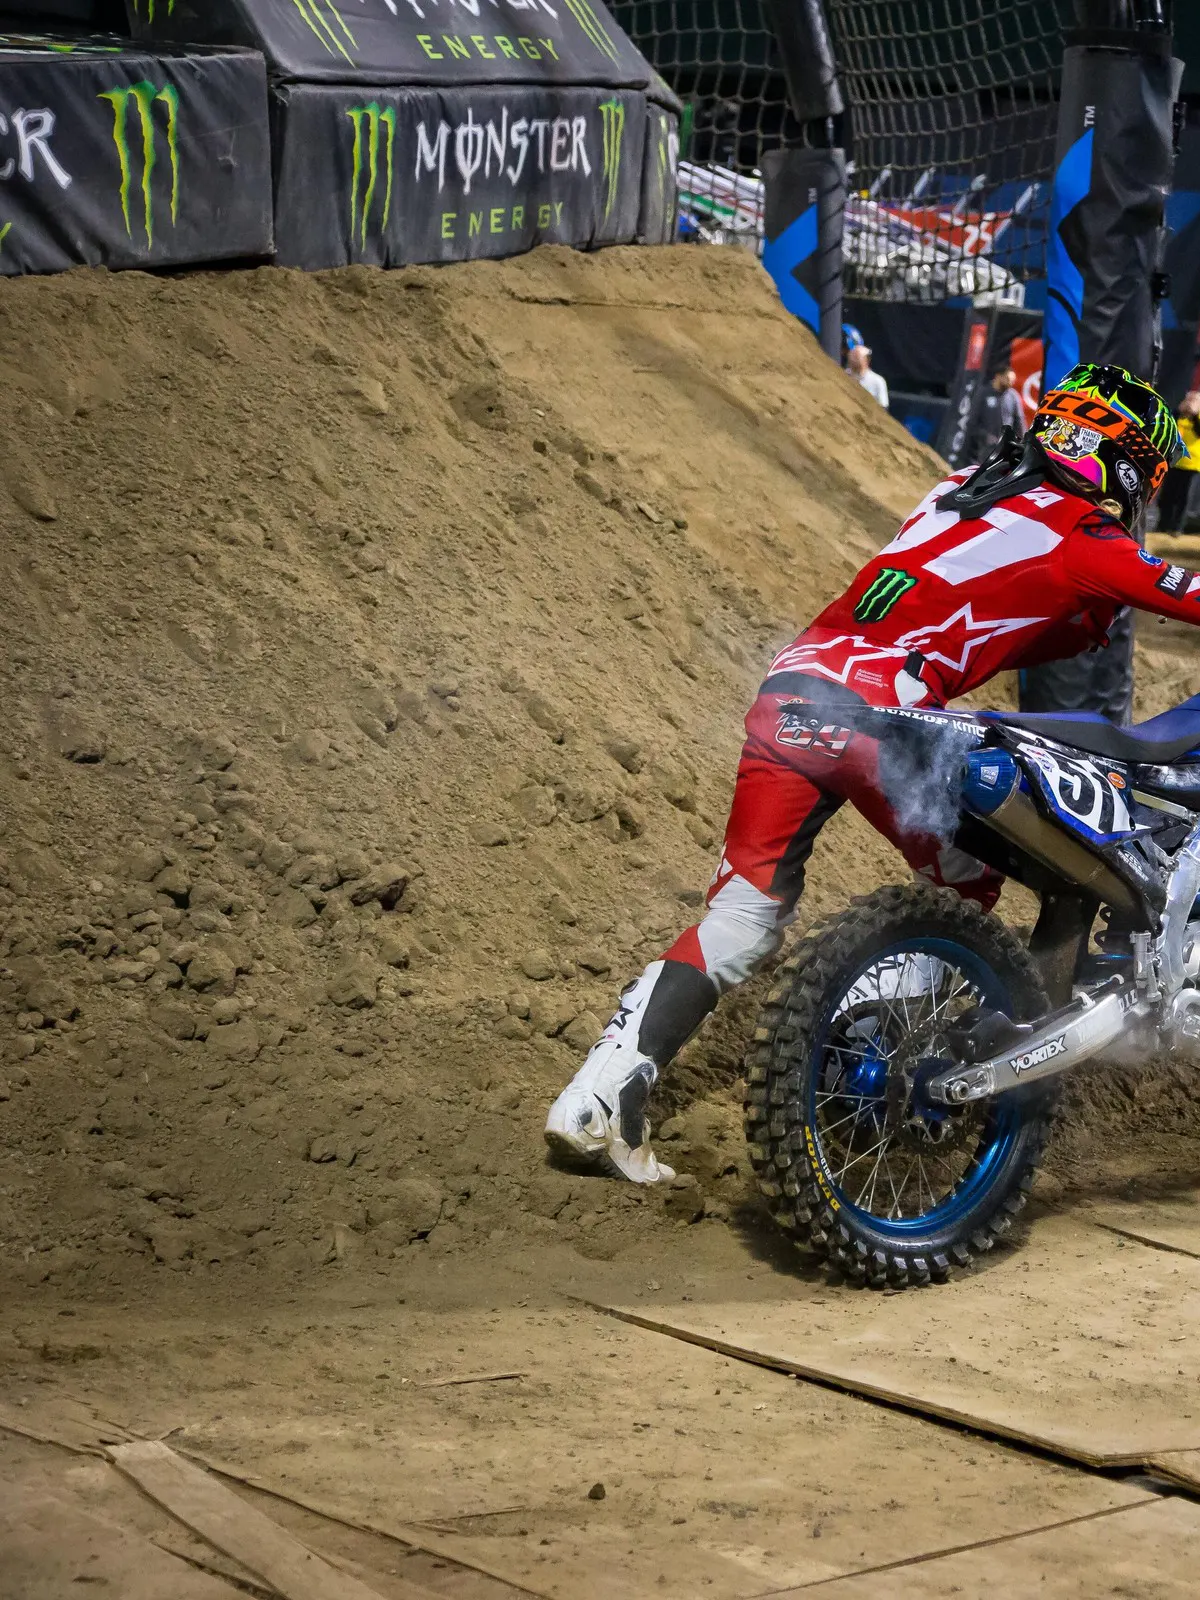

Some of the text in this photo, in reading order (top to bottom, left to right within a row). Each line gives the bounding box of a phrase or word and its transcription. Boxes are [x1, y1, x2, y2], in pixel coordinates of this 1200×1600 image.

[415, 34, 560, 61] ENERGY
[1084, 105, 1096, 128] TM
[414, 105, 592, 195] MONSTER
[441, 202, 563, 239] ENERGY
[872, 706, 949, 725] DUNLOP
[1009, 1034, 1068, 1076] VORTEX
[804, 1125, 841, 1212] DUNLOP
